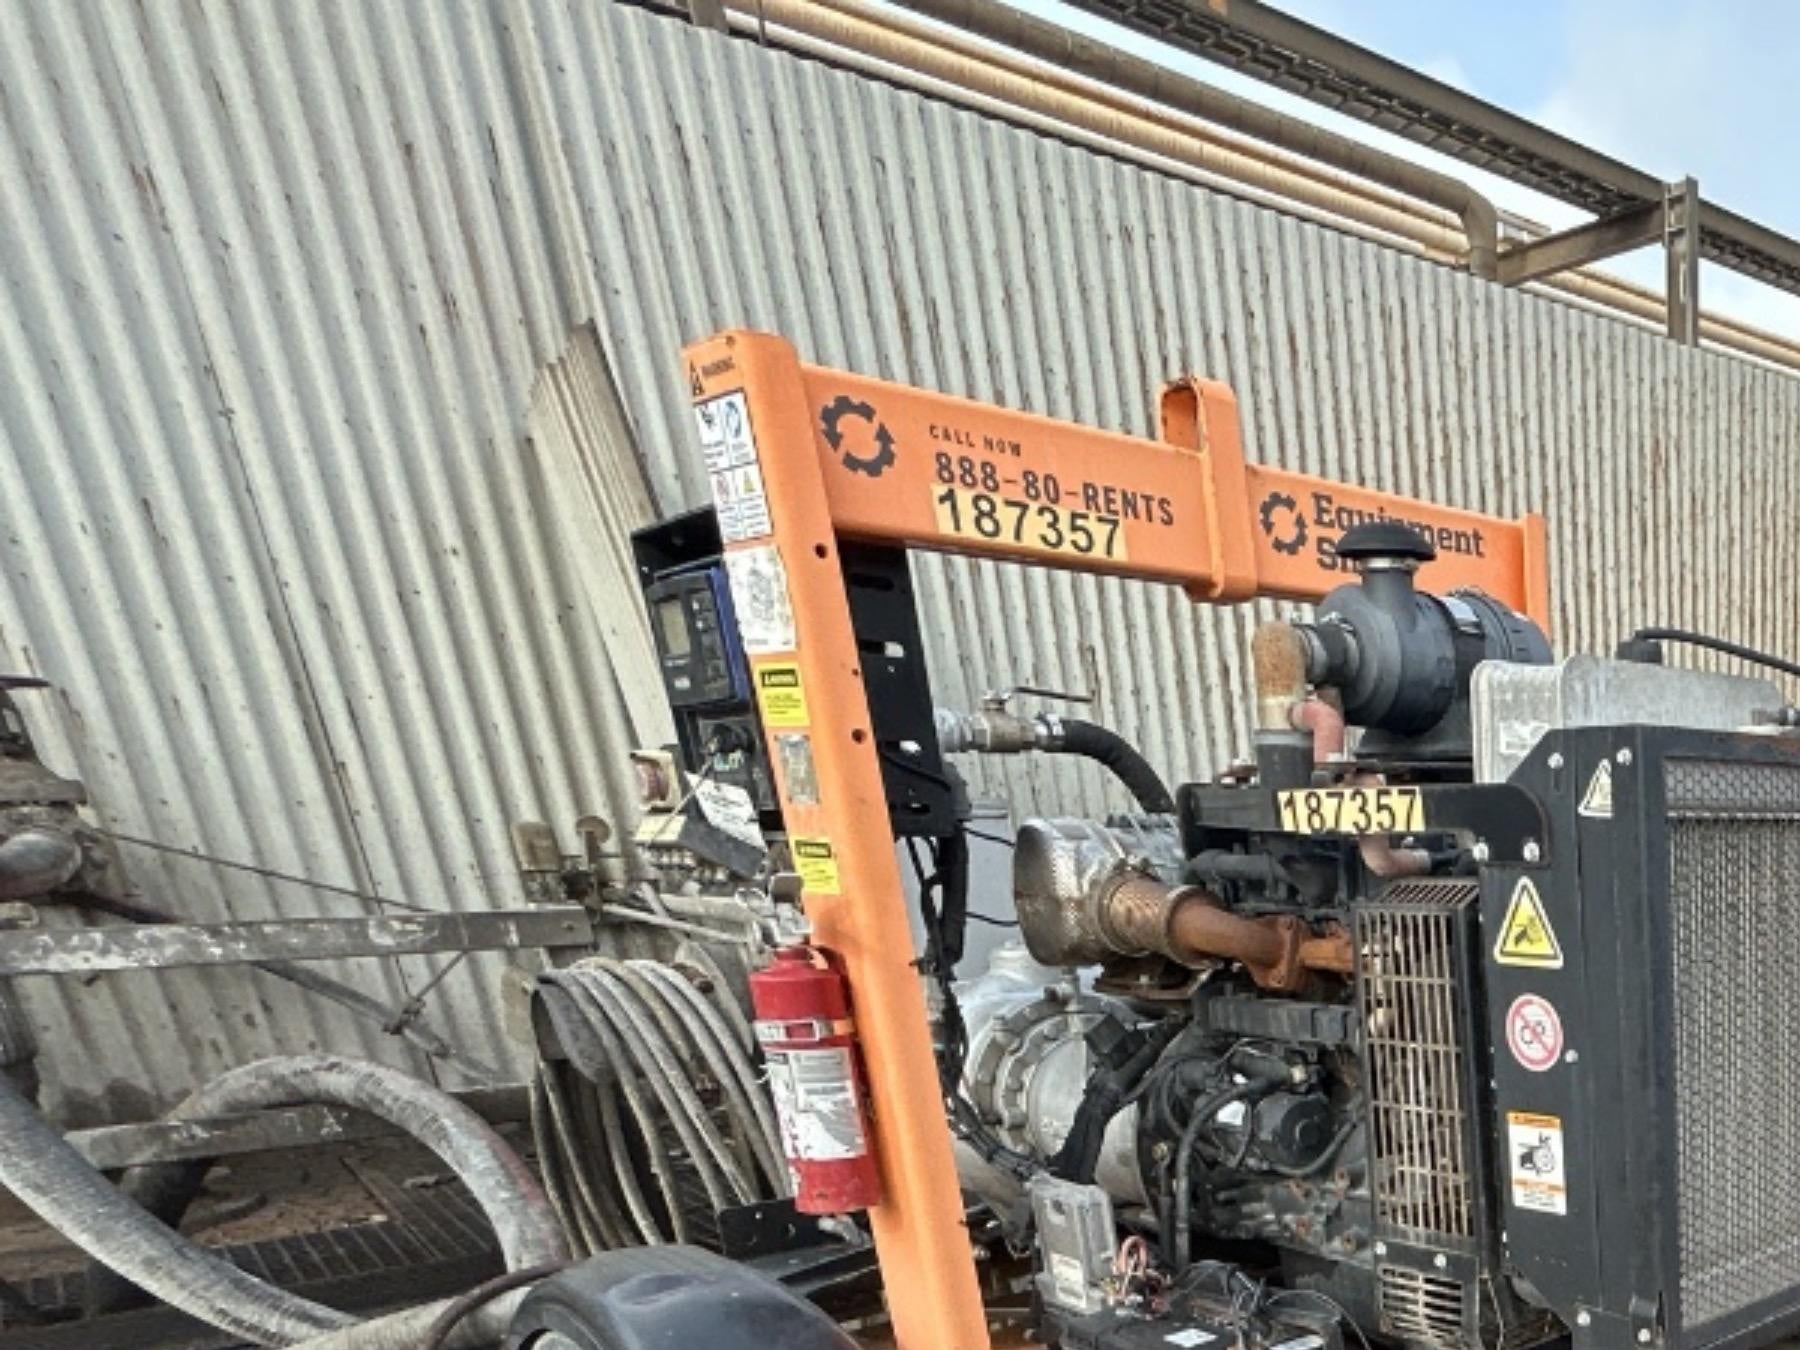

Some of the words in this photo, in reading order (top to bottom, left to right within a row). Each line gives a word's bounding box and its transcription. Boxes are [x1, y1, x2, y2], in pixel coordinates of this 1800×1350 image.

[929, 424, 975, 448] CALL
[983, 436, 1022, 457] NOW
[935, 452, 1174, 526] 888-80-RENTS
[938, 487, 1120, 557] 187357
[1312, 491, 1485, 558] Equiment
[1283, 788, 1417, 832] 187357
